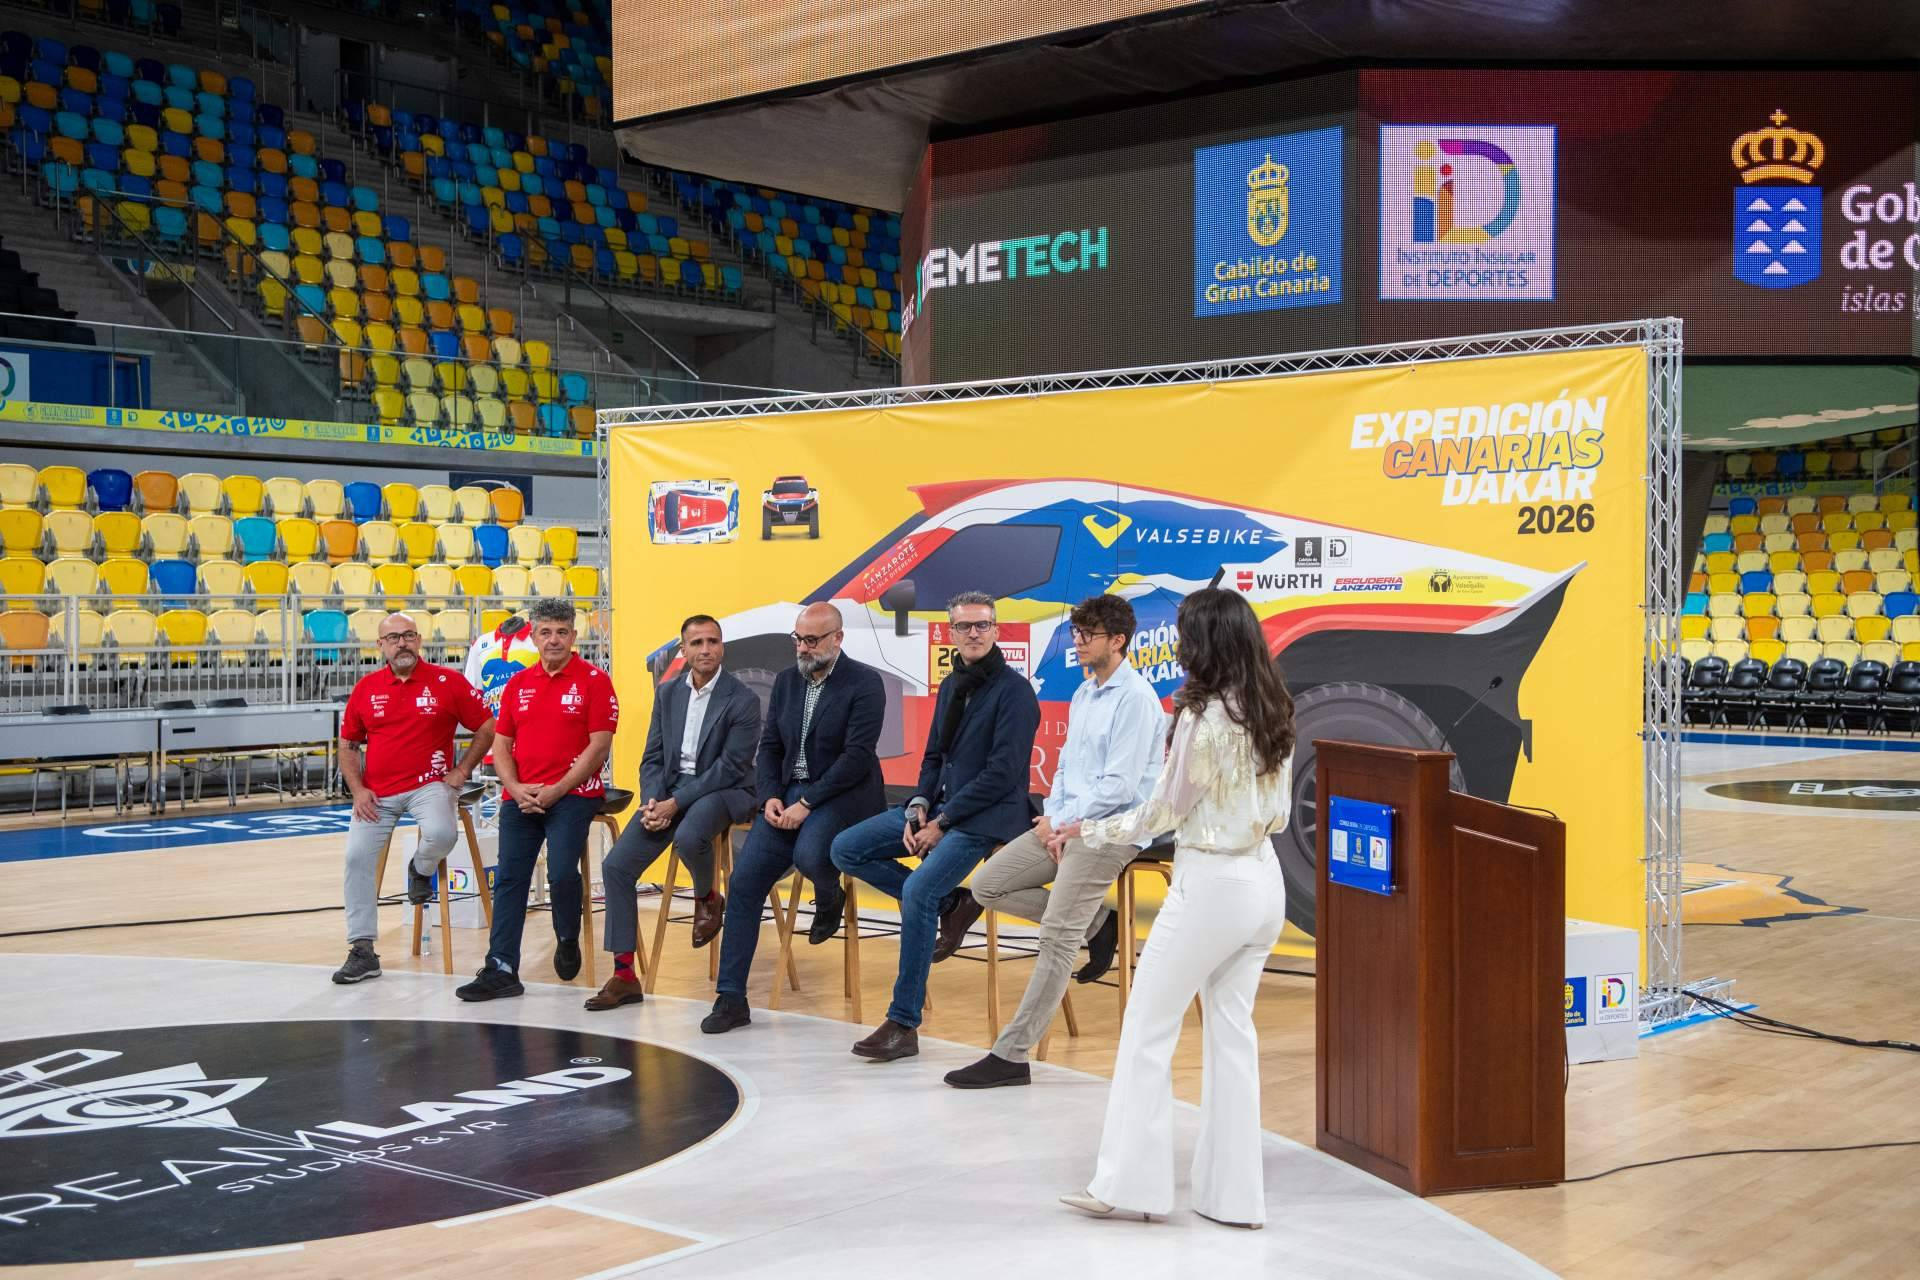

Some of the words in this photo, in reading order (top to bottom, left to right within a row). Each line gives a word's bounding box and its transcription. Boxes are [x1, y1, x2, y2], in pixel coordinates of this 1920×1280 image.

[1841, 229, 1894, 269] de
[1215, 257, 1288, 280] Cabildo
[1291, 250, 1317, 272] de
[1427, 270, 1528, 287] DEPORTES
[1205, 283, 1251, 302] Gran
[1255, 273, 1330, 297] Canaria
[1842, 285, 1906, 312] islas
[1350, 388, 1608, 449] EXPEDICIÓN
[1383, 429, 1604, 479] CANARIAS
[1441, 467, 1597, 506] DAKAR
[1517, 503, 1595, 534] 2026
[1136, 528, 1263, 545] VALSEBIKE
[864, 543, 915, 590] LANZAROTE
[1335, 577, 1403, 585] ESCUDERIA
[1333, 584, 1402, 592] LANZAROTE
[217, 1143, 413, 1193] STUDIOS
[412, 1135, 444, 1146] &
[440, 1120, 508, 1138] VR
